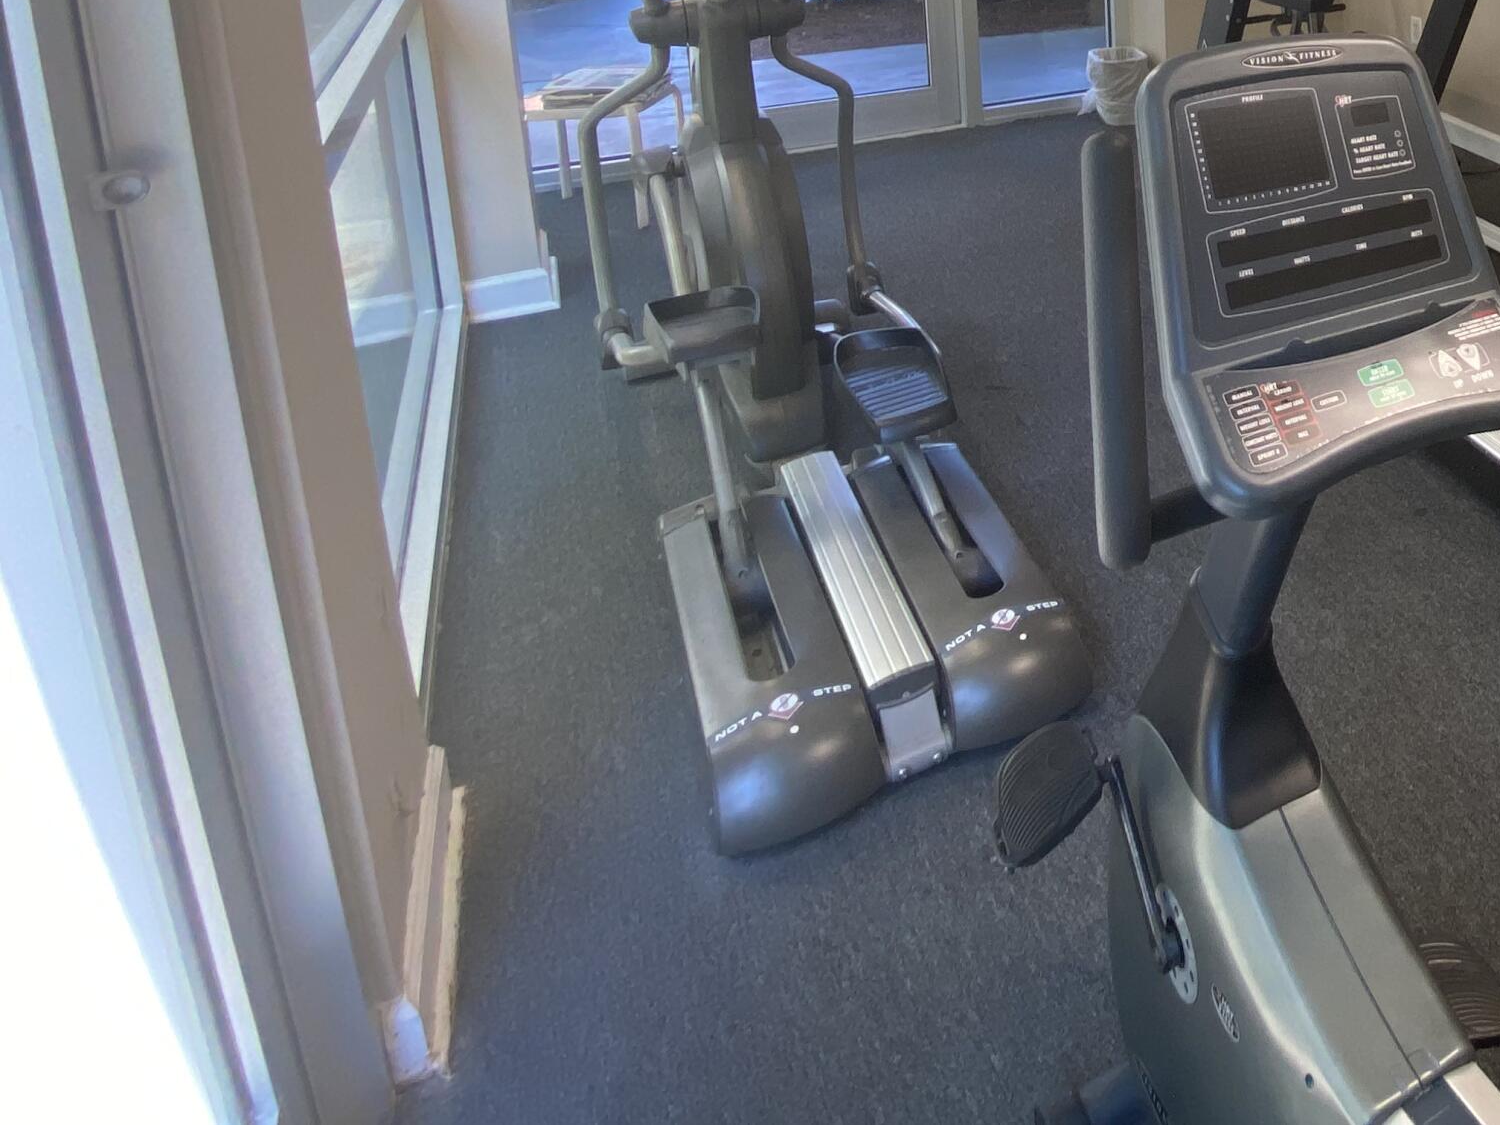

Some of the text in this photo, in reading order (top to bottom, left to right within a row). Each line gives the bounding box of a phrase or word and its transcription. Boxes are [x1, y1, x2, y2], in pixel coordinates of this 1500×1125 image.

[1249, 49, 1337, 66] VISION FITNESS
[1229, 228, 1246, 237] SPEED
[945, 600, 1059, 652] NOT A STEP
[714, 683, 852, 742] NOT A STEP
